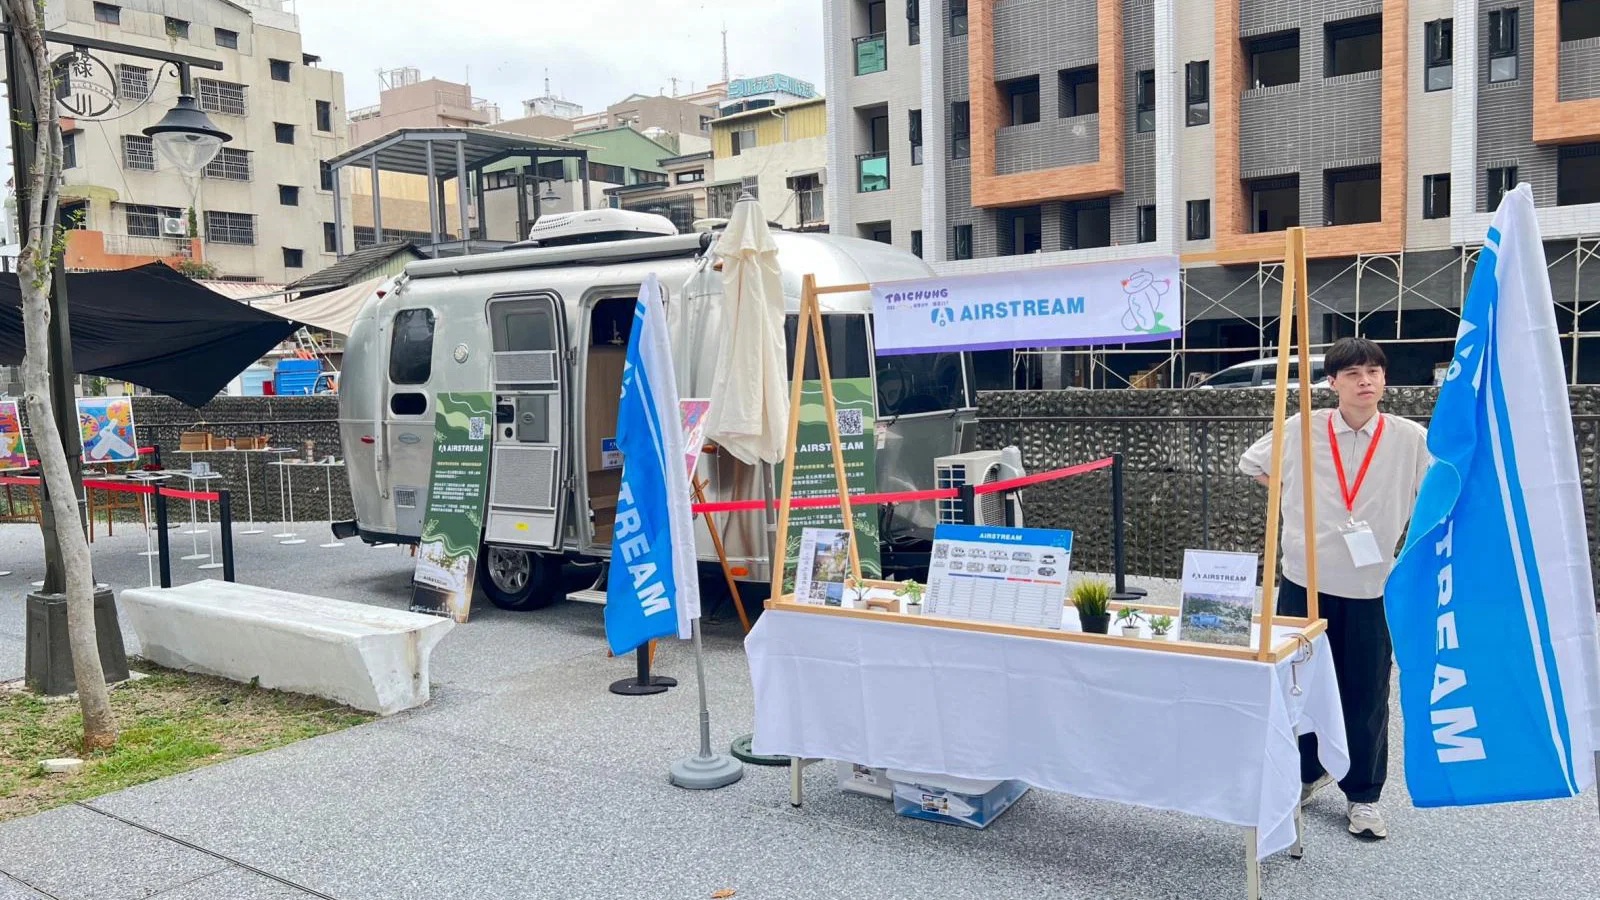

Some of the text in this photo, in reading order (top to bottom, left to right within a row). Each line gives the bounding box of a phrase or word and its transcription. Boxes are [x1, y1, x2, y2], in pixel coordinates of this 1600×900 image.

[885, 288, 949, 304] TAICHUNG
[959, 297, 1085, 322] AIRSTREAM
[446, 444, 484, 452] AIRSTREAM
[800, 441, 864, 453] AIRSTEAM
[615, 464, 671, 617] TREAM
[979, 532, 1023, 541] AIRSTREAM
[1203, 573, 1247, 582] AIRSTREAM
[1430, 515, 1487, 763] TREAM
